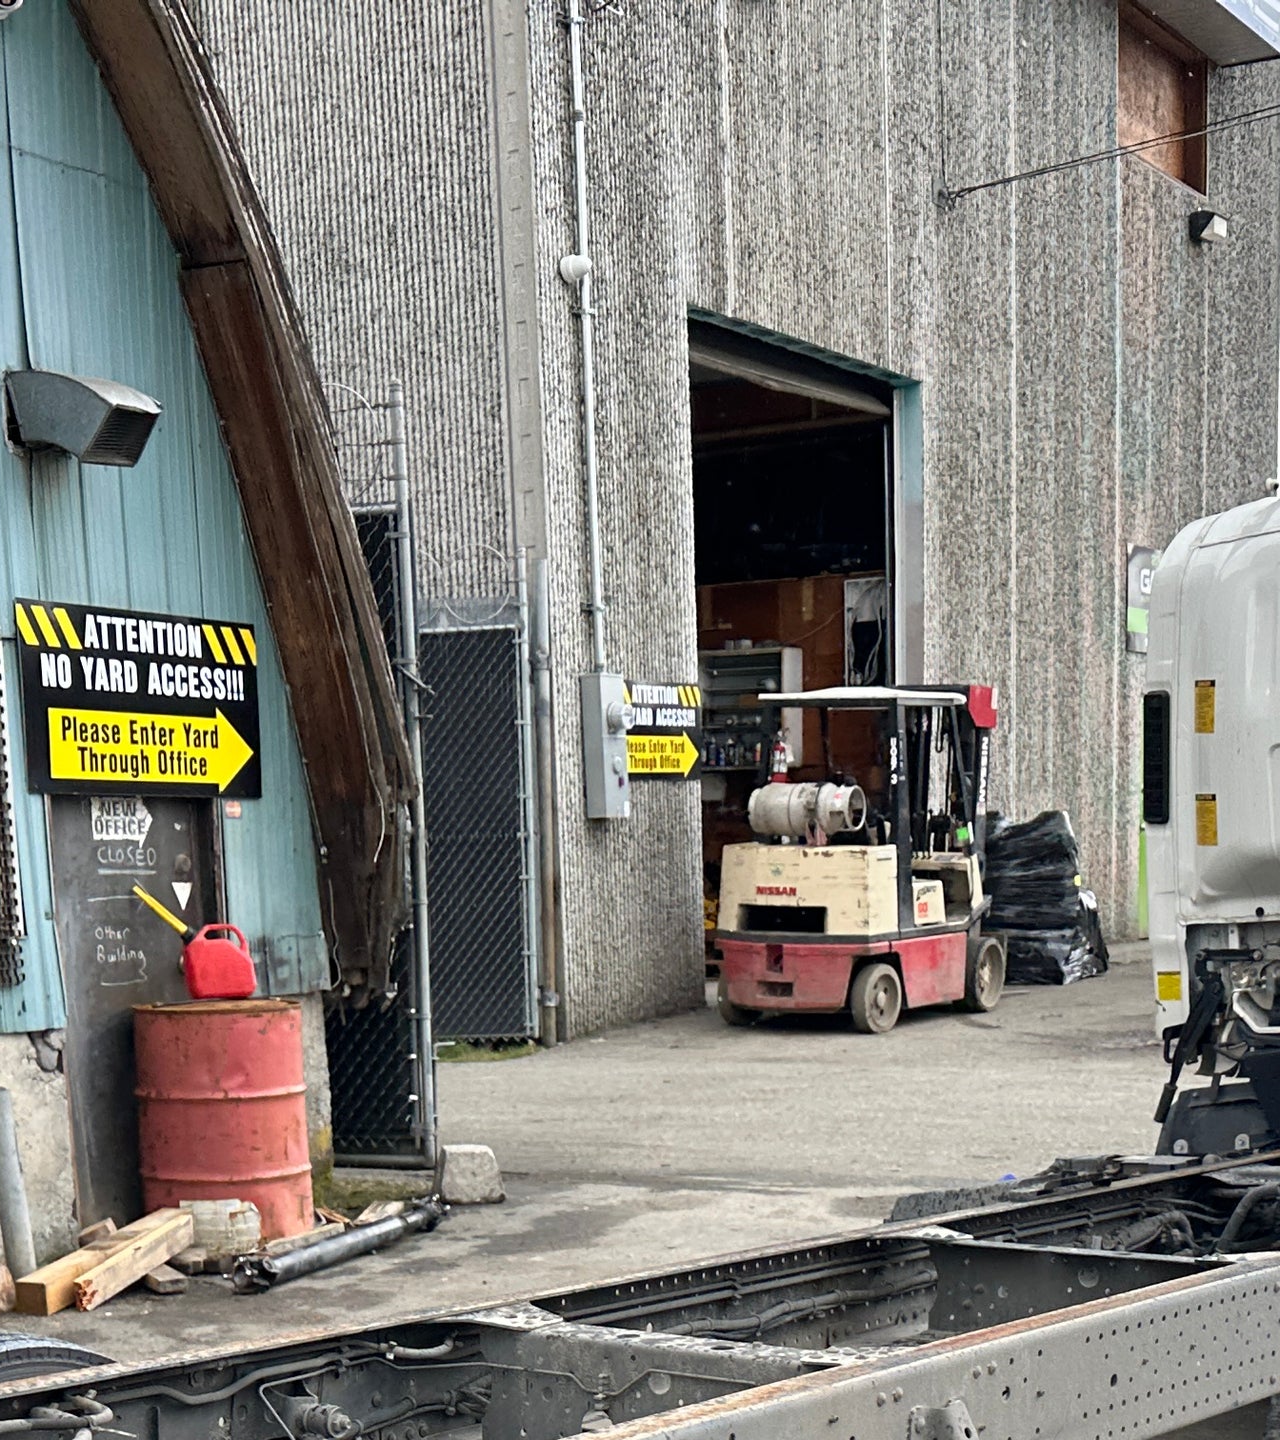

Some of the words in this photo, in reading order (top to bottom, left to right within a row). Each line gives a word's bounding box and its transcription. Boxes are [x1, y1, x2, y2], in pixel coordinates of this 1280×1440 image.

[84, 614, 202, 659] ATTENTION
[40, 652, 72, 689] NO
[80, 656, 138, 693] YARD
[148, 662, 245, 701] ACCESS!!!
[631, 684, 679, 705] ATTENTION
[61, 716, 121, 744] Please
[129, 720, 175, 747] Enter
[183, 723, 219, 749] Yard
[626, 740, 646, 753] lease
[649, 739, 667, 753] Enter
[670, 740, 685, 753] Yard
[77, 747, 149, 778] Through
[158, 750, 208, 776] Office
[629, 755, 657, 771] Through
[660, 755, 680, 769] Office
[100, 801, 137, 817] NEW
[94, 818, 147, 835] OFFICE
[97, 846, 157, 866] CLOSED
[755, 886, 797, 897] NISSAN
